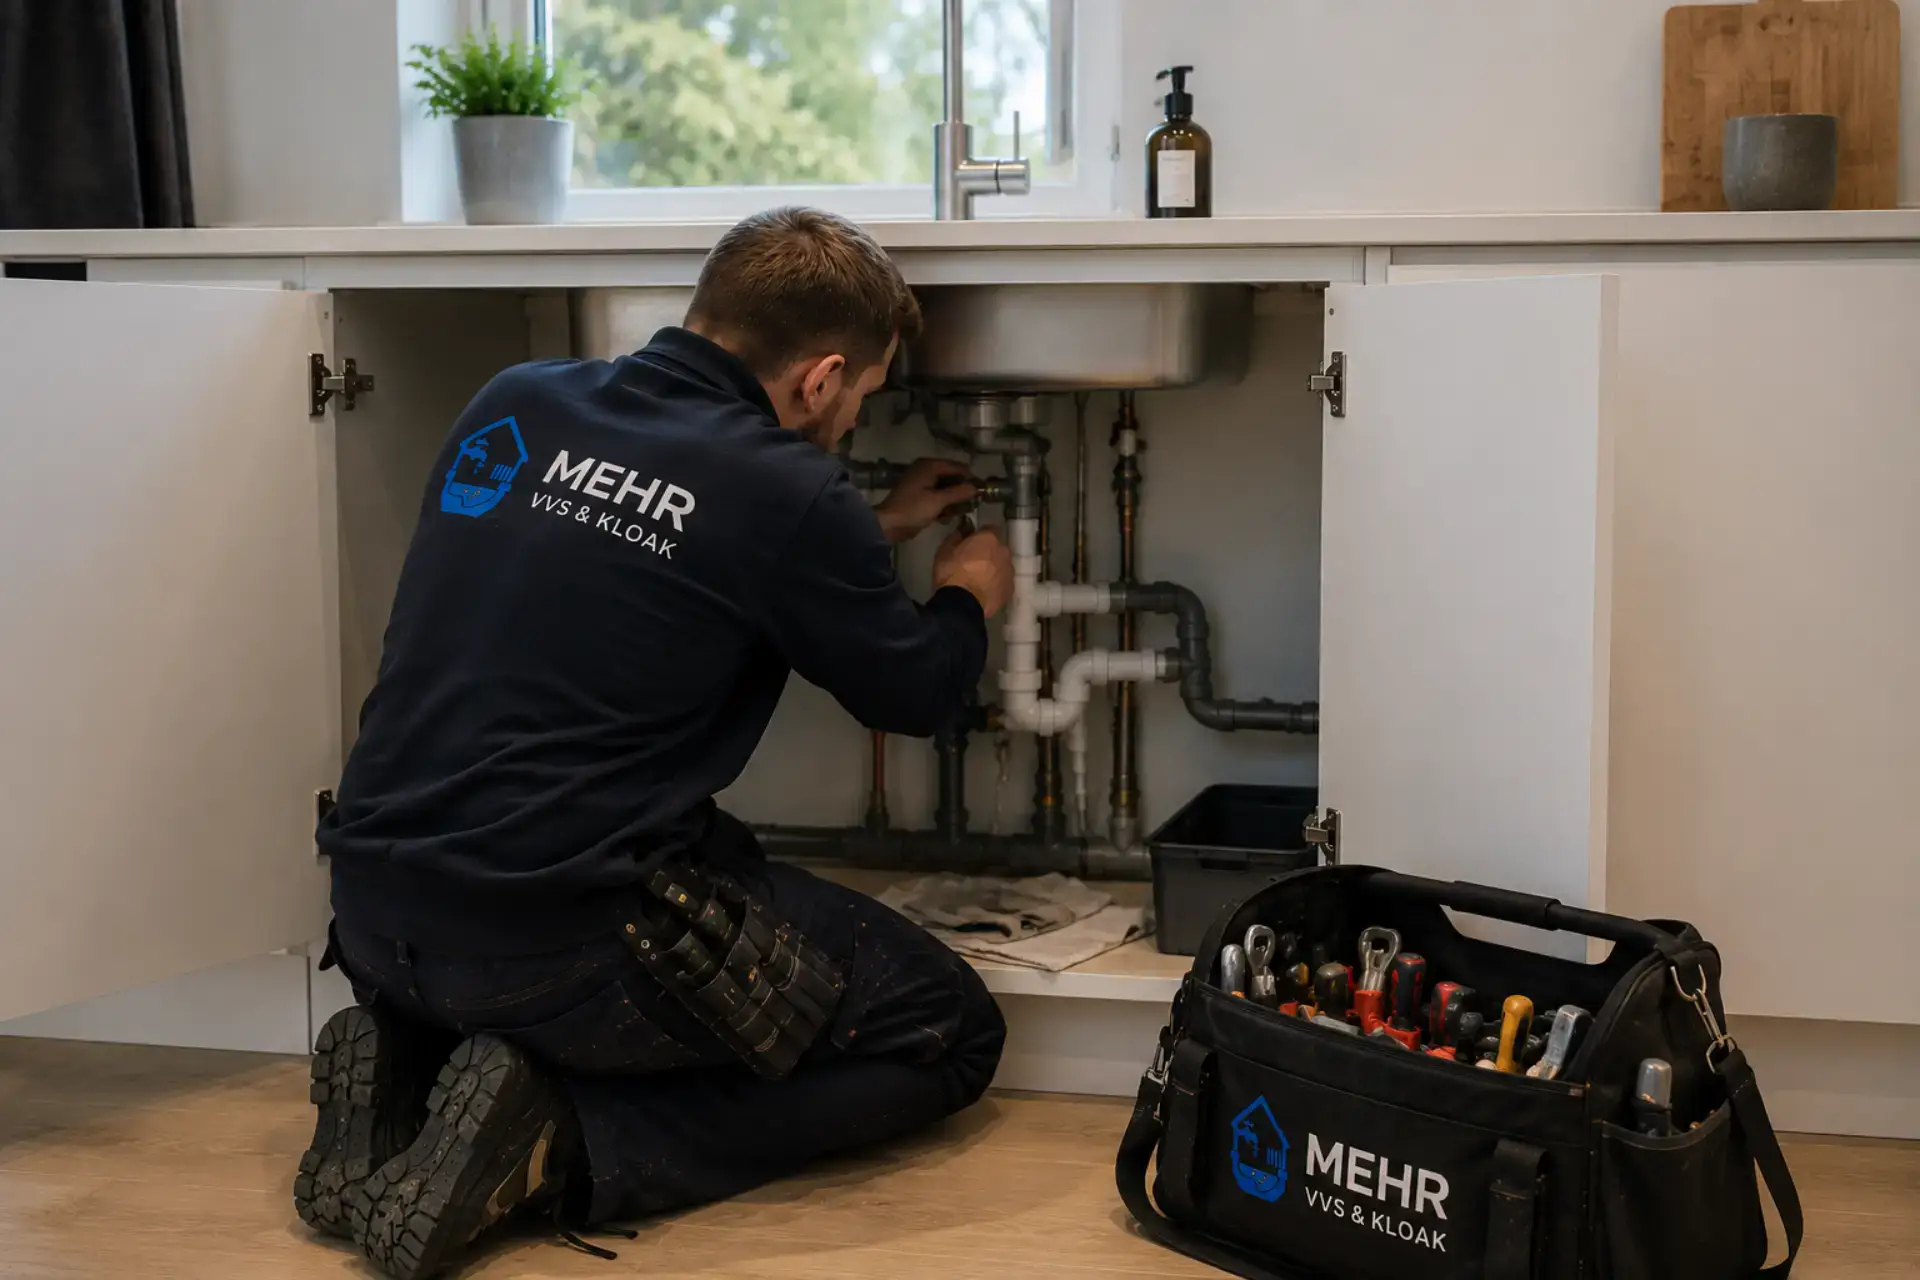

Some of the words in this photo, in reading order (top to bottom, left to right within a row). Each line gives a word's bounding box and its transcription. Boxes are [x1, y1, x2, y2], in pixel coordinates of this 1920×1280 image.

[531, 491, 573, 516] VVS
[574, 505, 590, 524] &
[595, 511, 677, 560] KLOAK
[542, 449, 696, 532] MEHR
[1305, 1132, 1450, 1221] MEHR
[1305, 1186, 1345, 1218] VVS
[1351, 1204, 1365, 1226] &
[1371, 1210, 1447, 1253] KLOAK
